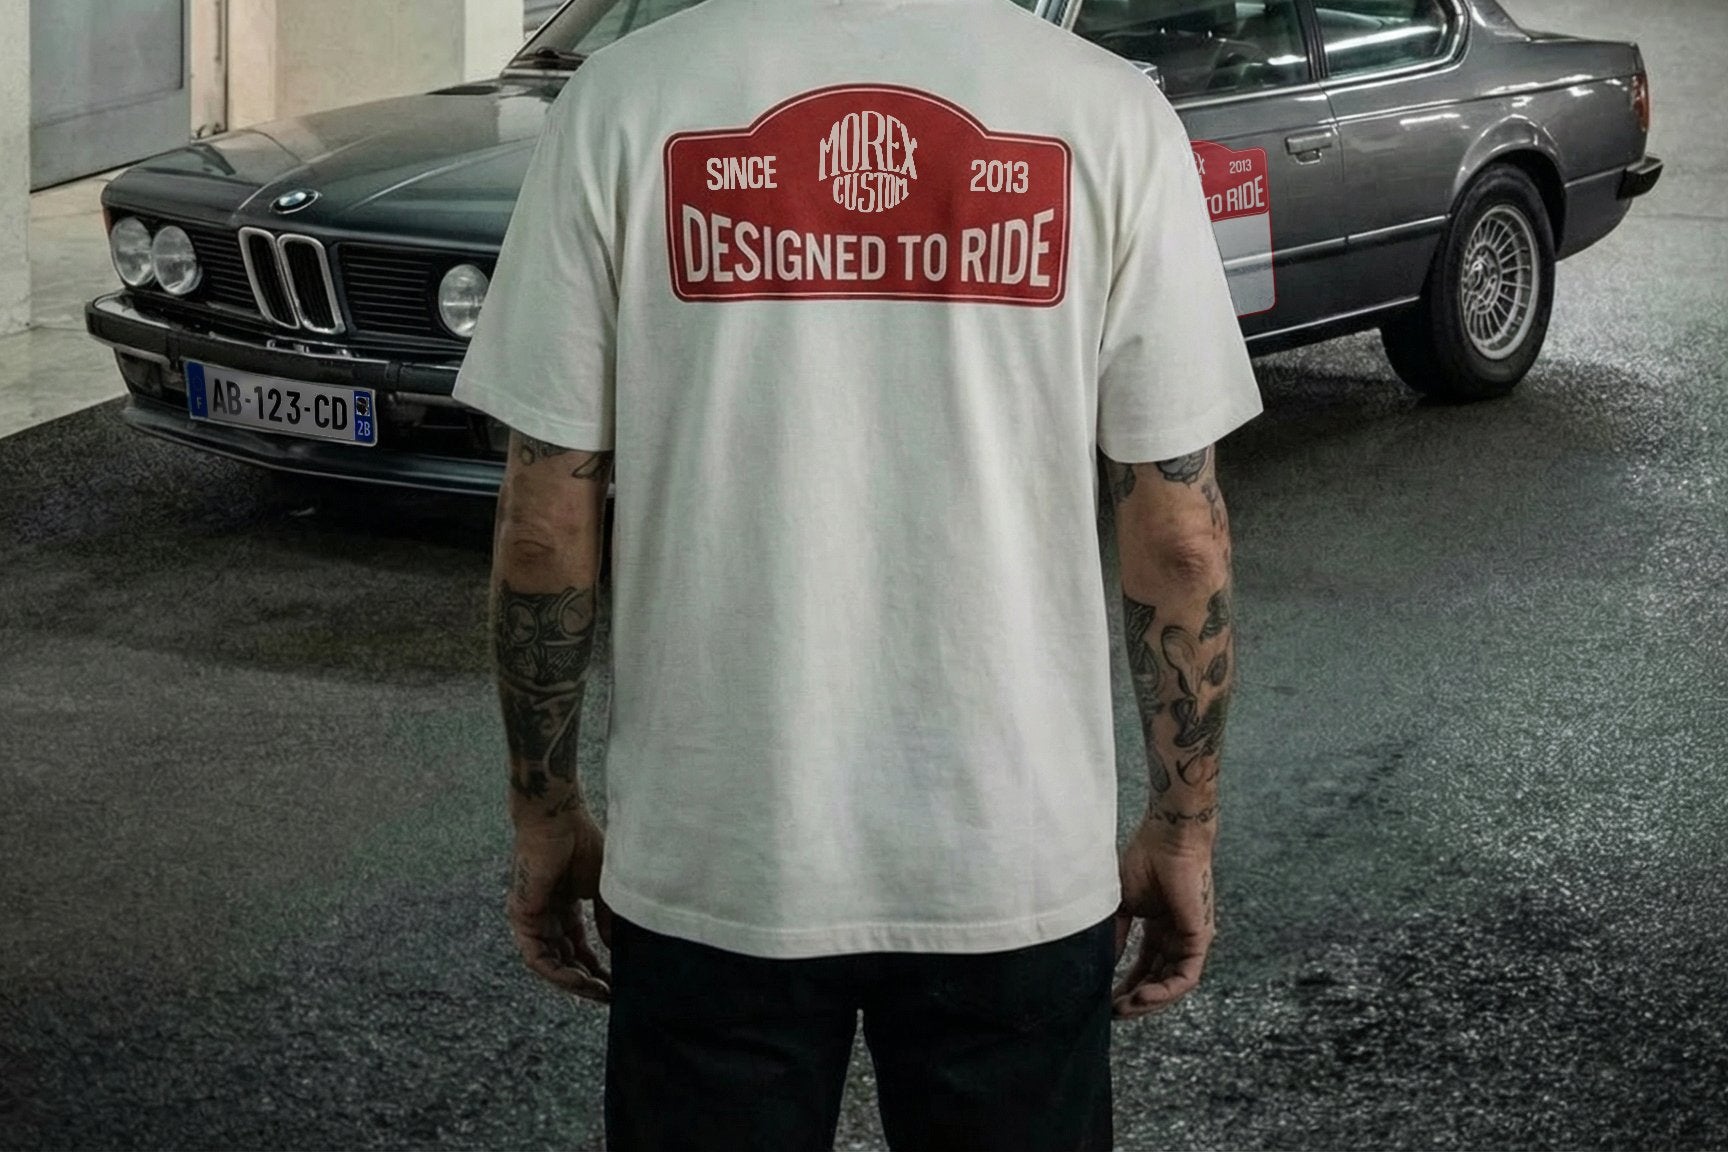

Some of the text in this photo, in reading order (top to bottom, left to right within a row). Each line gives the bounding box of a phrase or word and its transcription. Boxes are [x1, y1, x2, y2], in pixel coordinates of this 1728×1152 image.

[818, 111, 917, 181] MOREX
[1229, 159, 1252, 173] 2013
[706, 156, 1029, 193] SINCE 2013
[833, 172, 909, 213] CUSTOM
[1227, 176, 1264, 212] RIDE
[682, 204, 1055, 287] DESIGNED TO RIDE
[213, 378, 348, 430] AB-123-CD
[358, 421, 370, 436] 2B
